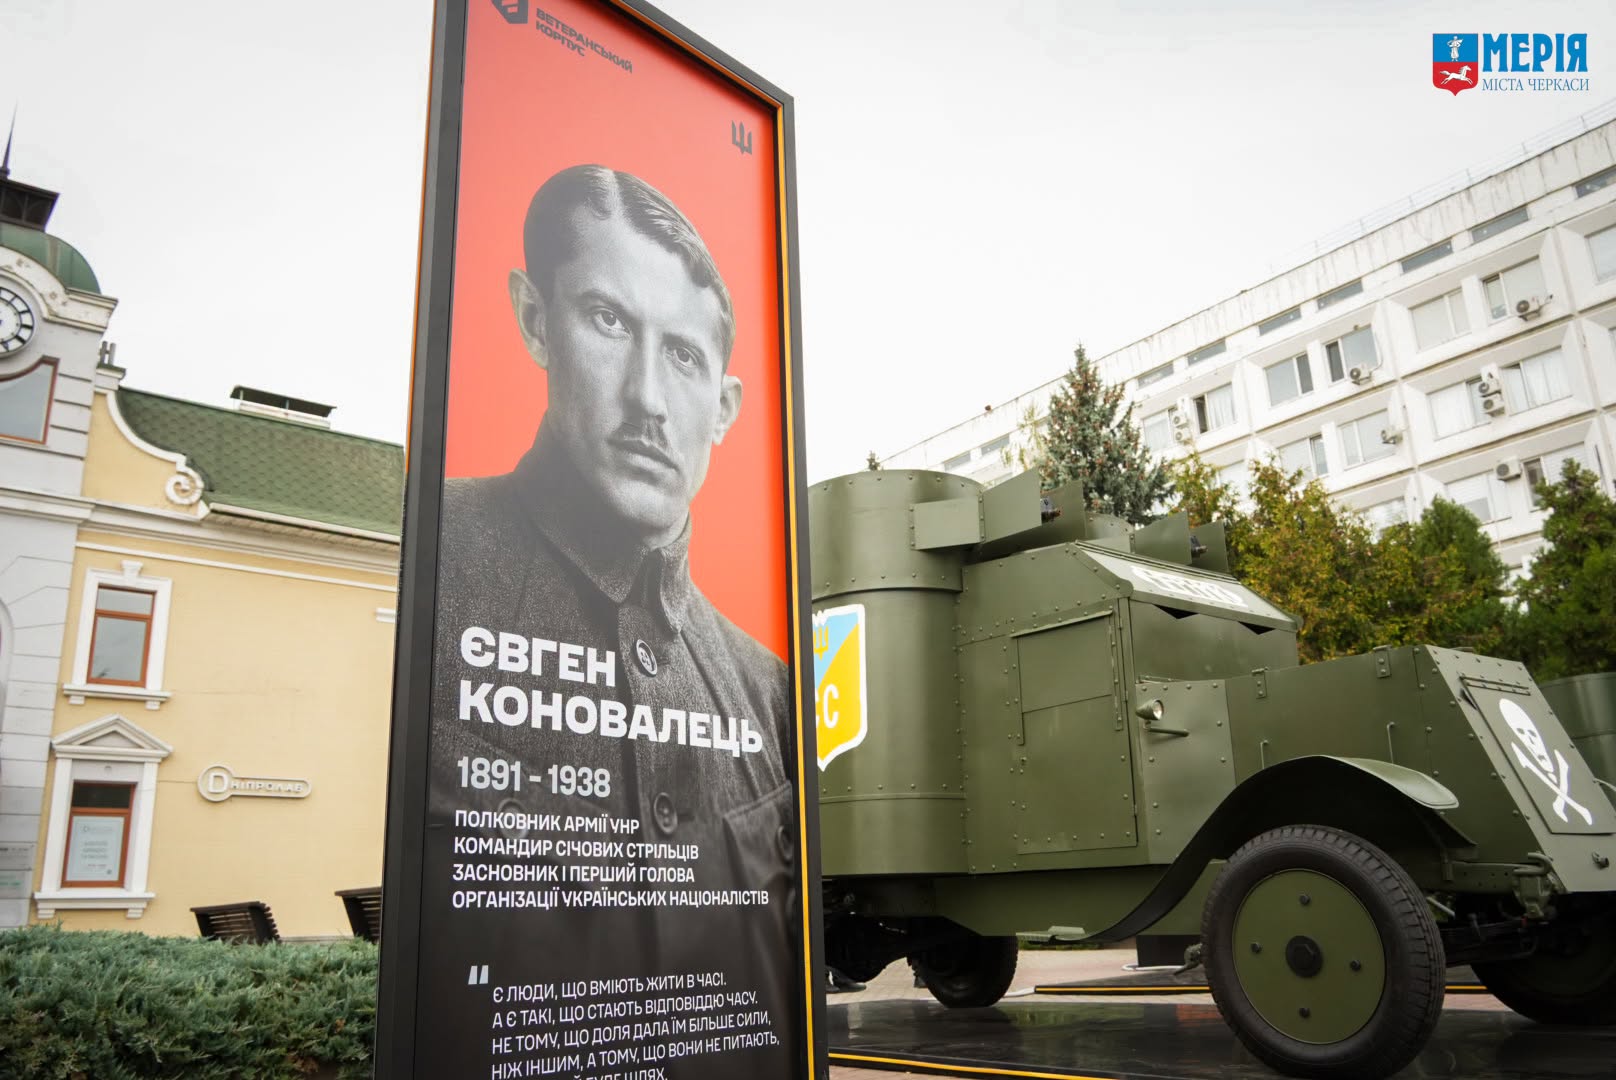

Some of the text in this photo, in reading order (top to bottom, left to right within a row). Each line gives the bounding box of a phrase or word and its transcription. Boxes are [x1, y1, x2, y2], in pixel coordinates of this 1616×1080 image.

[536, 20, 585, 57] КОРПУС
[536, 7, 633, 74] ВЕТЕРАНСЬКИЙ
[460, 626, 616, 687] ЄВГЕН
[459, 679, 763, 757] КОНОВАЛЕЦЬ
[455, 810, 640, 834] ПОЛКОВНИК АРМІЇ УНР
[454, 836, 699, 861] КОМАНДИР СІЧОВИХ СТРІЛЬЦІВ
[452, 863, 695, 883] ЗАСНОВНИК І ПЕРШИЙ ГОЛОВА
[452, 885, 769, 910] ОРГАНІЗАЦІЇ УКРАЇНСЬКИХ НАЦІОНАЛІСТІВ
[492, 972, 727, 1003] Є ЛЮДИ, ЩО ВМІЮТЬ ЖИТИ В ЧАСІ.
[492, 991, 758, 1029] А Є ТАКІ, ЩО СТАЮТЬ ВІДПОВІДДЮ ЧАСУ.
[492, 1010, 771, 1055] НЕ ТОМУ, ЩО ДОЛЯ ДАЛА ЇМ БІЛЬШЕ СИЛИ,
[491, 1031, 780, 1080] НІЖ ІНШИМ, А ТОМУ, ЩО ВОНИ НЕ ПИТАЮТЬ,
